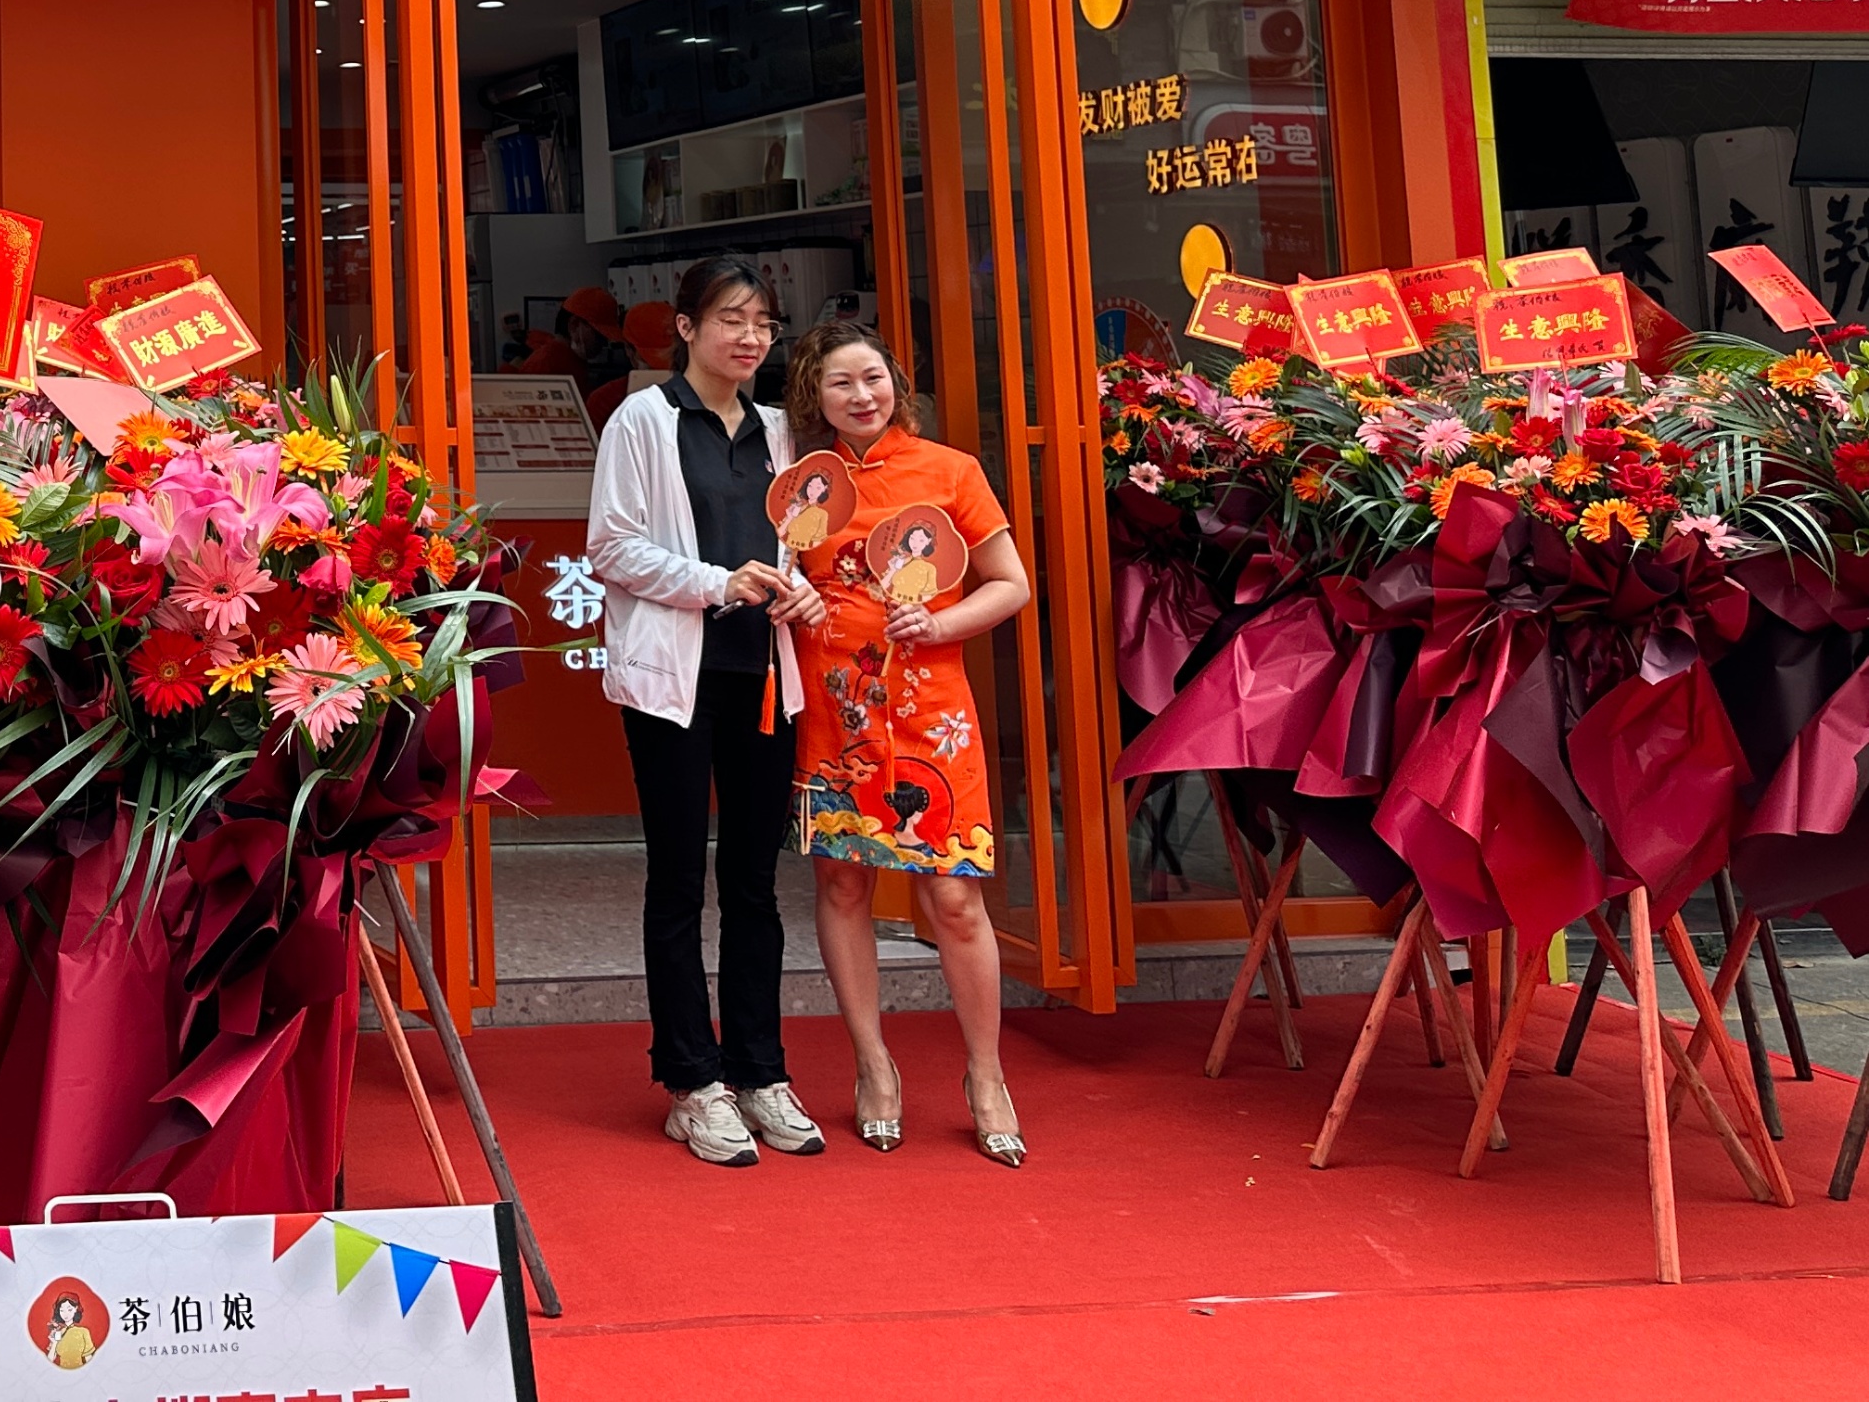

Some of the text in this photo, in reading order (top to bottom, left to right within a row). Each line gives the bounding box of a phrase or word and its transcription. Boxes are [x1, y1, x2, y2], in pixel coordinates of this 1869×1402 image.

[1078, 73, 1183, 135] 发财被爱
[1145, 135, 1259, 195] 好运常在
[129, 310, 228, 368] 財源廣進
[1315, 302, 1393, 335] 生意興隆
[1499, 307, 1610, 342] 生意興隆
[543, 554, 606, 629] 茶
[119, 1291, 256, 1336] 茶伯娘
[138, 1341, 241, 1357] CHABONIANG
